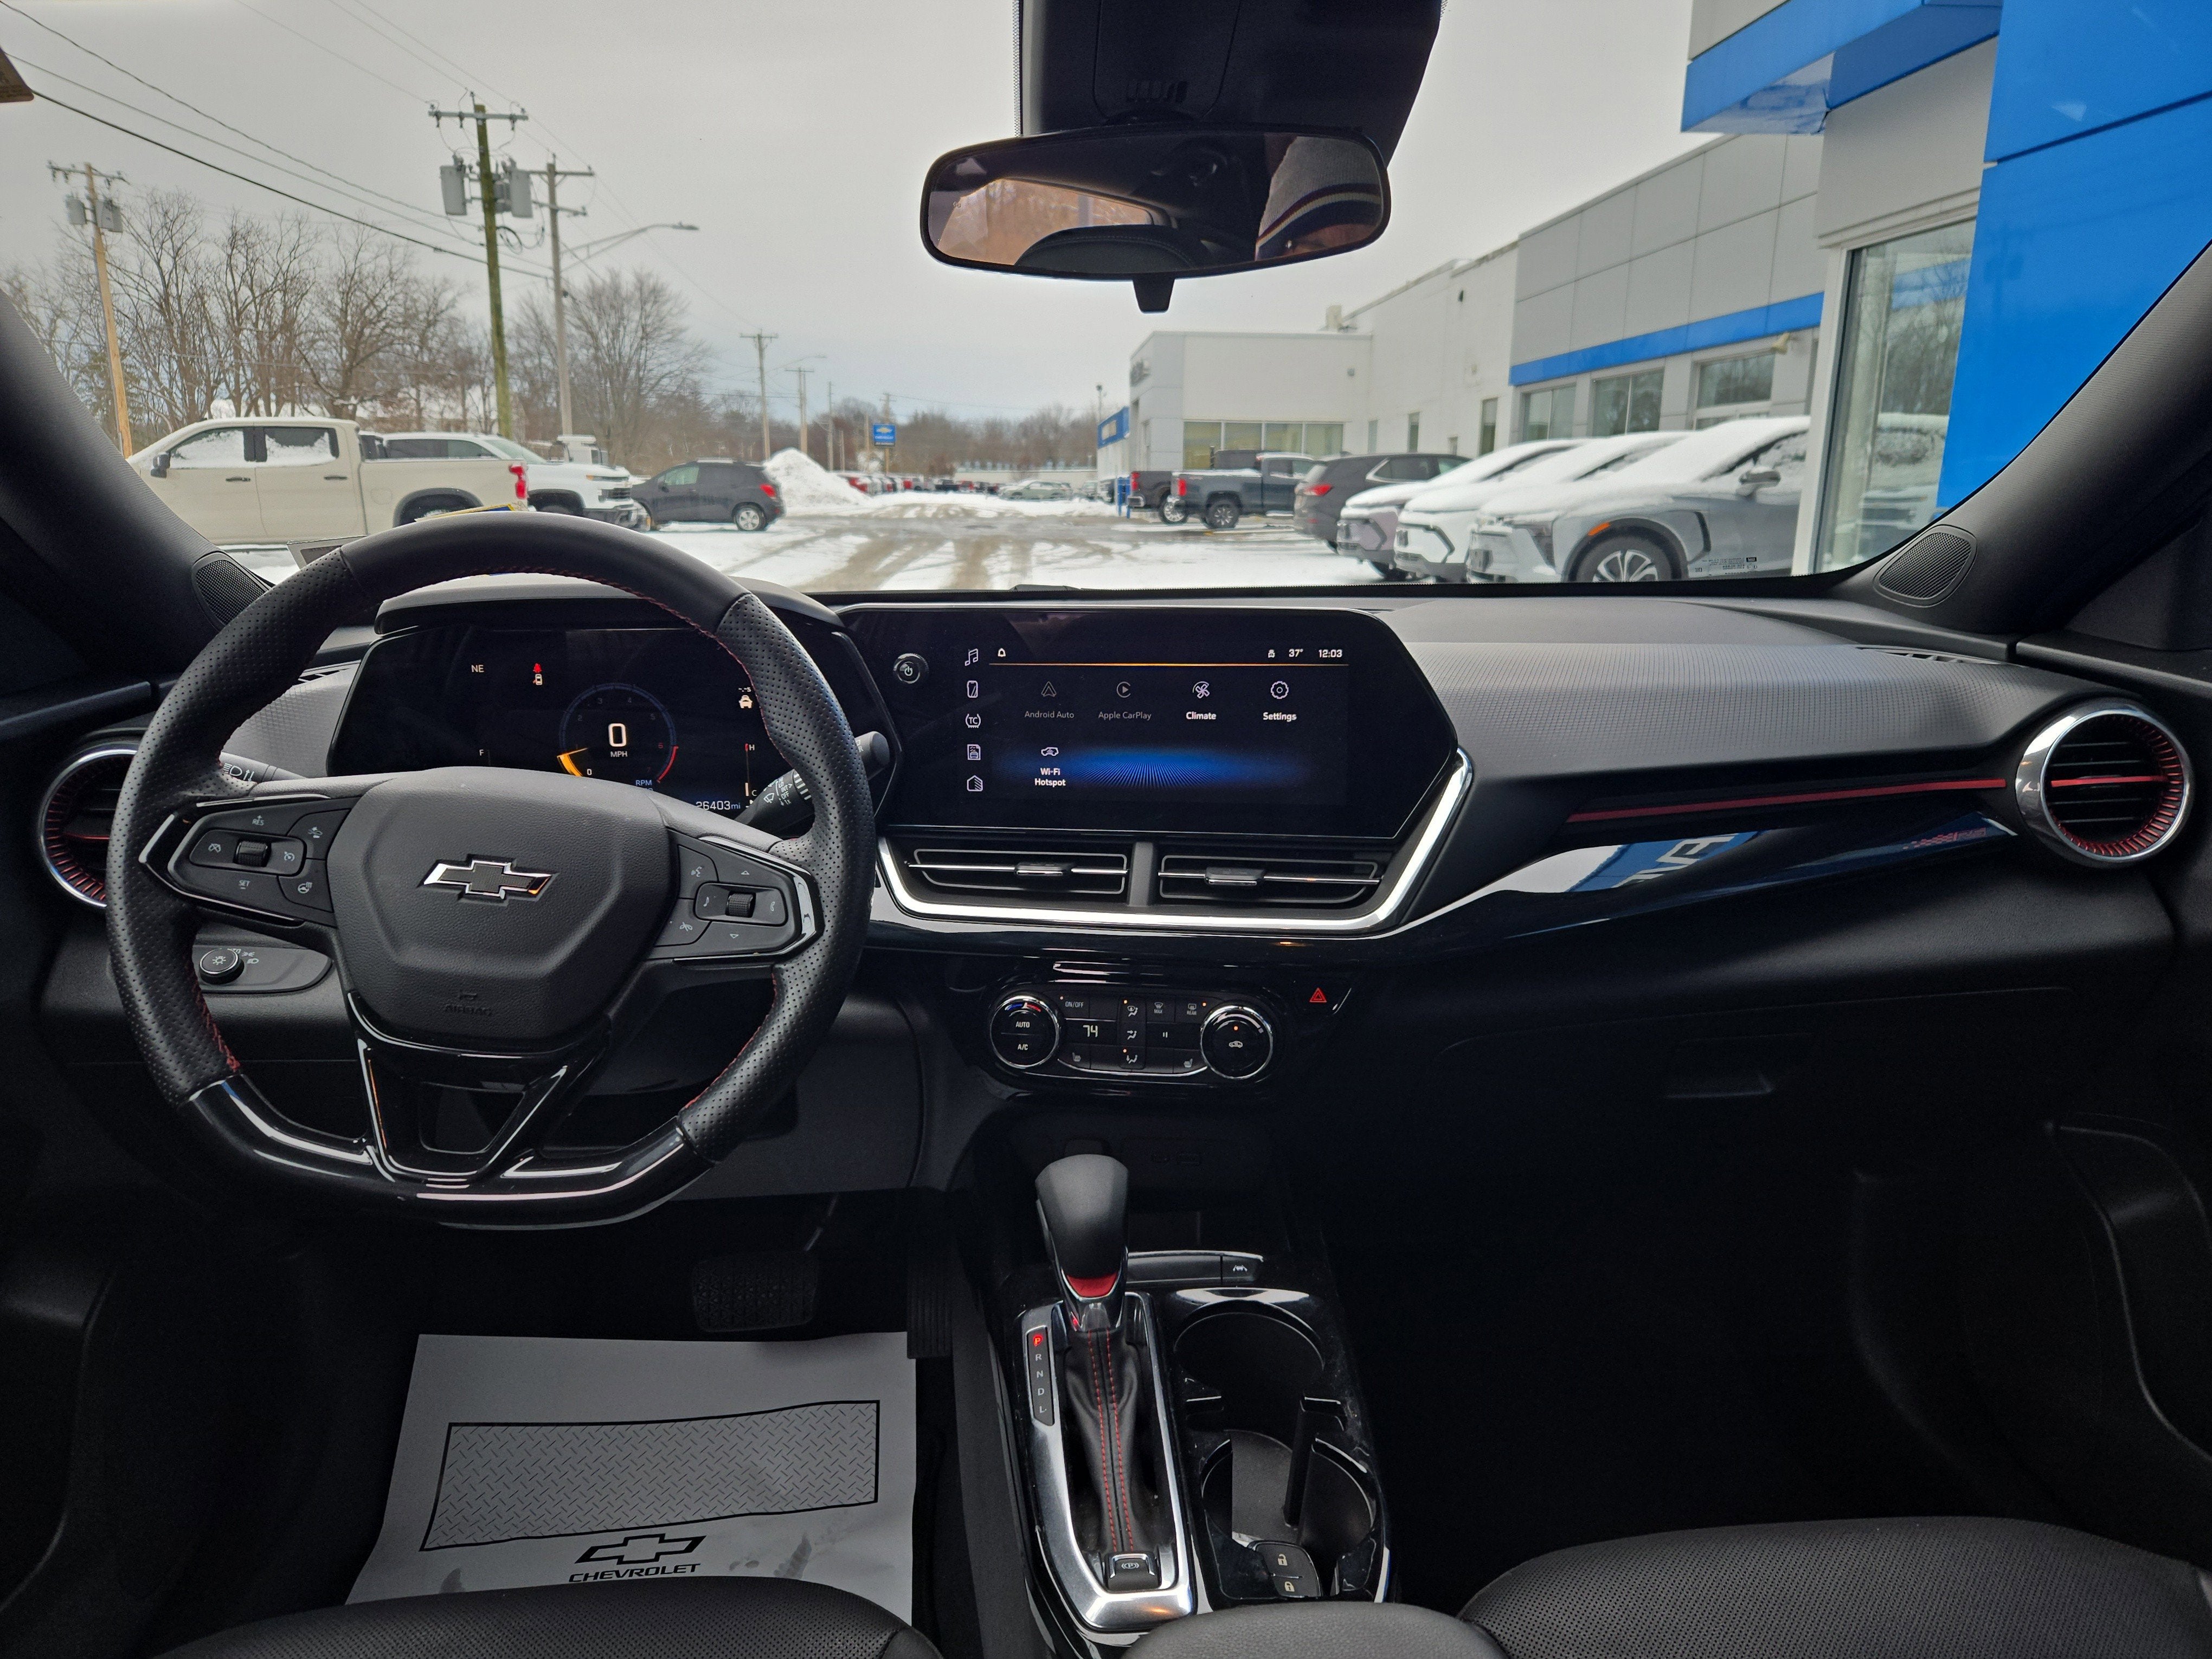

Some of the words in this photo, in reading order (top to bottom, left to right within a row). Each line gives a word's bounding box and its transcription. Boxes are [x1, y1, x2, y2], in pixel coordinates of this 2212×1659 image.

[1319, 649, 1343, 658] 12:03
[1098, 711, 1121, 721] Apple
[1122, 711, 1152, 721] CarPlay
[1186, 711, 1217, 720] Climate
[1263, 712, 1297, 722] Settings
[608, 723, 627, 747] 0
[1040, 768, 1060, 776] Wi-Fi
[1034, 779, 1066, 787] Hotspot
[781, 791, 789, 800] OFF
[252, 818, 265, 826] RES
[1083, 1025, 1098, 1038] 74
[1034, 1337, 1041, 1346] P
[1036, 1370, 1044, 1379] N
[1038, 1388, 1045, 1396] D
[569, 1564, 700, 1583] CHEVROLET
